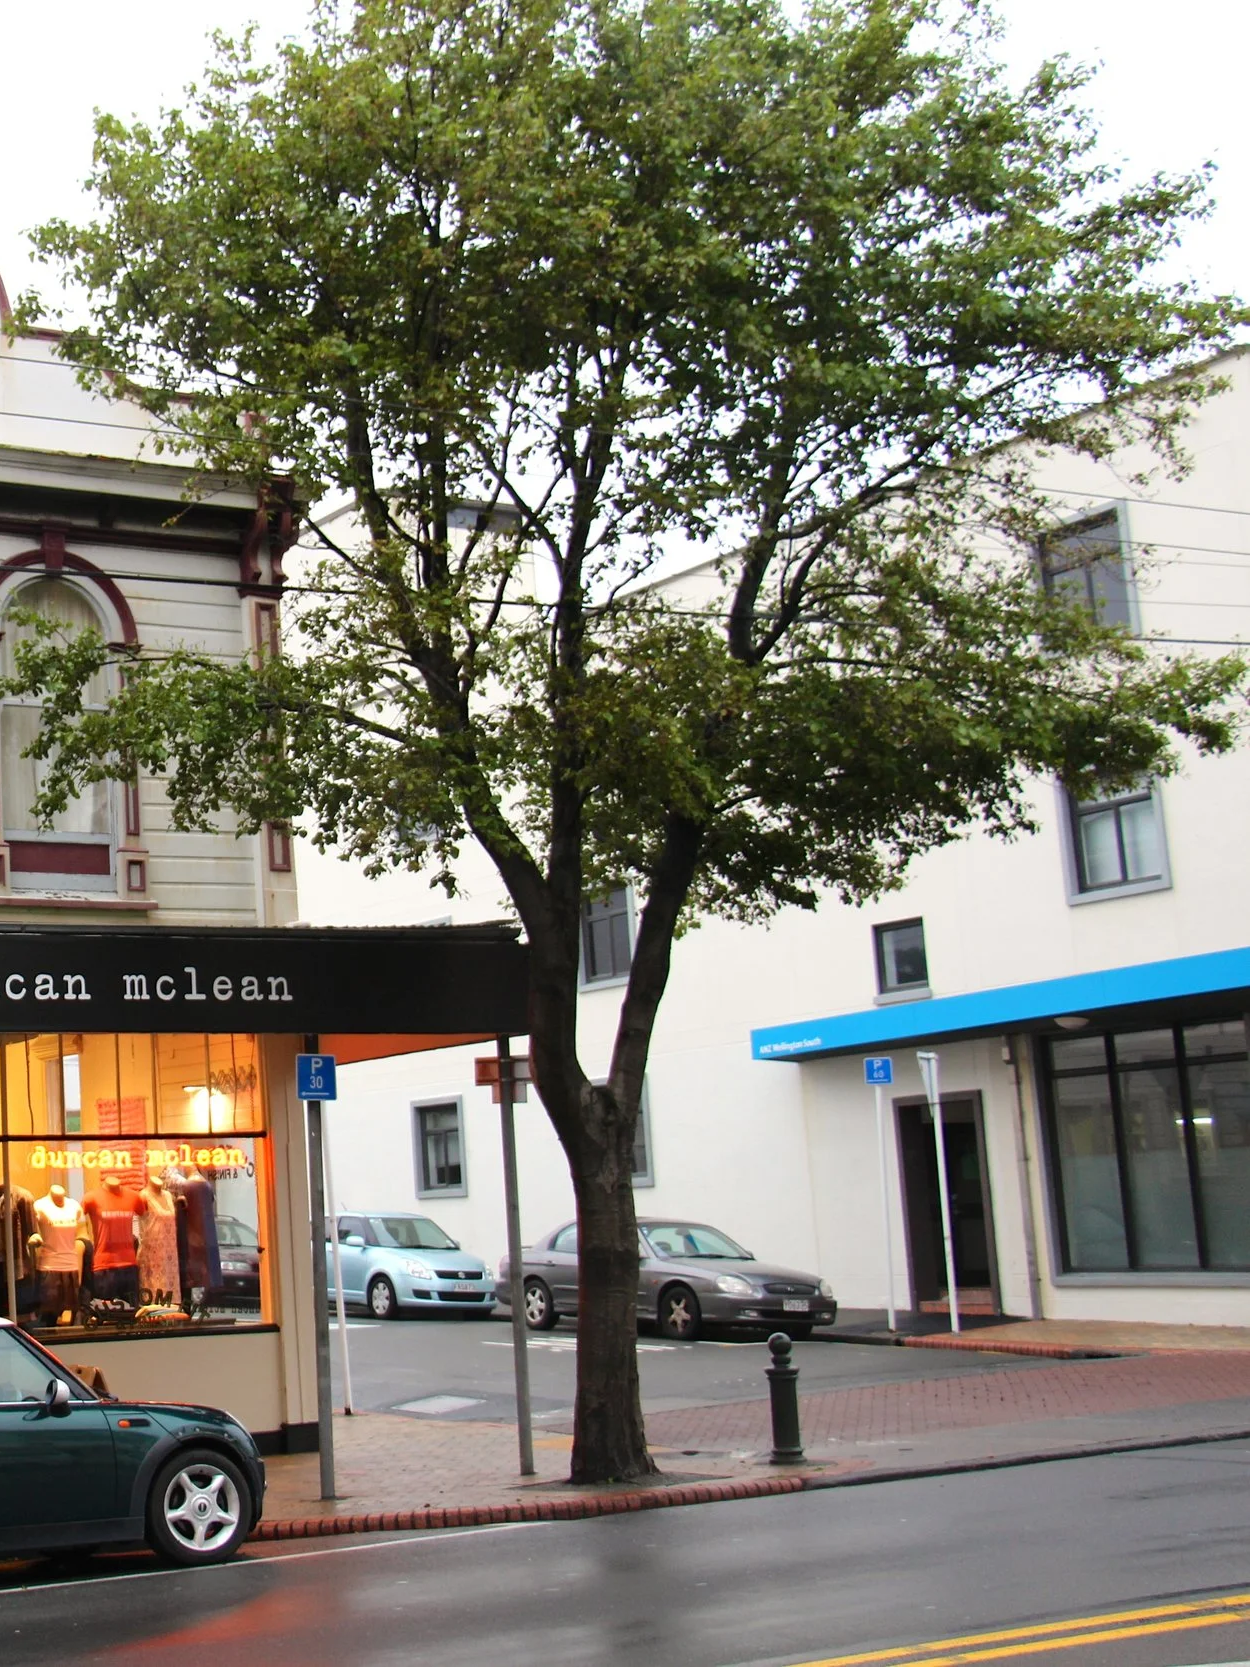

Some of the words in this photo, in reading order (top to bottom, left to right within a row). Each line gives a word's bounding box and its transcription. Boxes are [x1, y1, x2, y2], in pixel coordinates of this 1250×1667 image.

[122, 966, 293, 1001] mclean
[310, 1057, 323, 1075] P
[873, 1060, 883, 1070] P
[309, 1076, 323, 1090] 30
[30, 1144, 133, 1169] duncan
[145, 1143, 246, 1168] mclean
